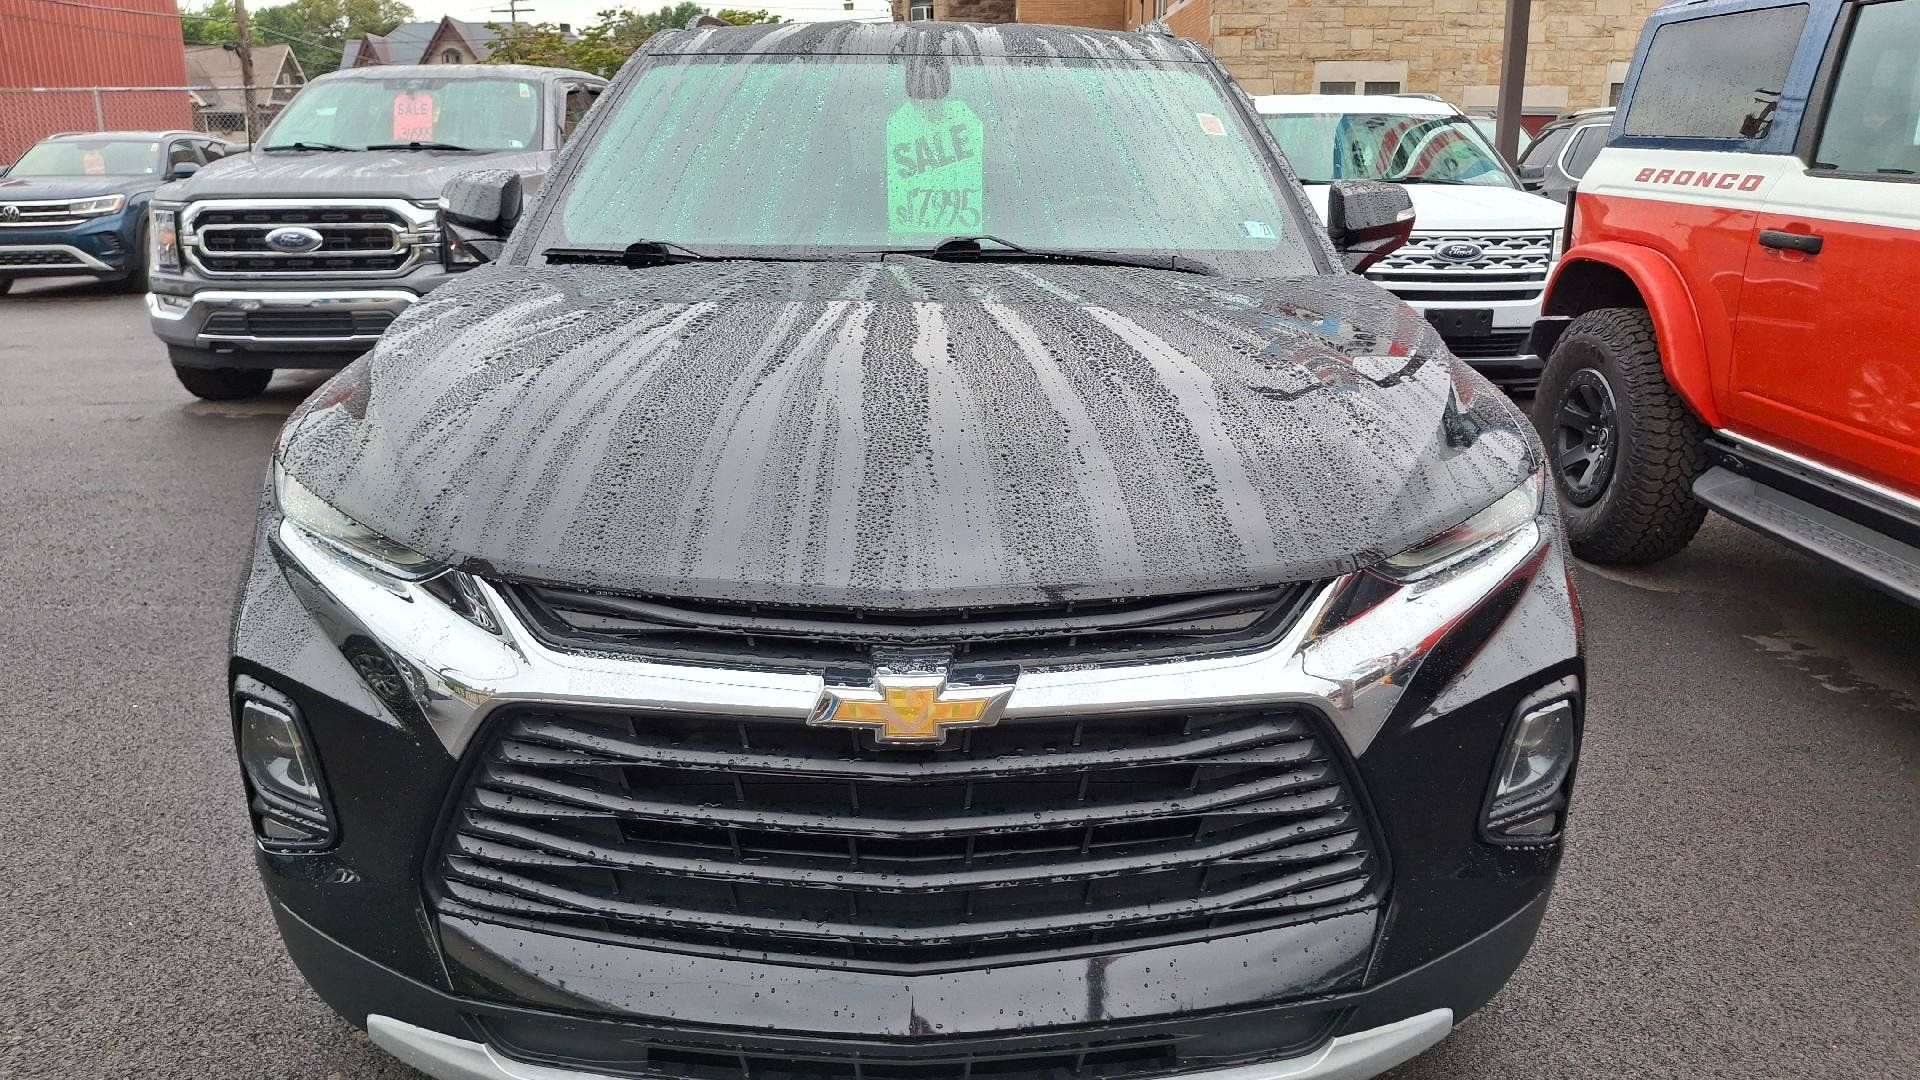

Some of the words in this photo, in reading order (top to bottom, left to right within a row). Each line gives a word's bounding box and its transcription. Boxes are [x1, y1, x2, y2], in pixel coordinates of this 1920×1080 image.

[398, 103, 429, 115] SALE
[893, 123, 976, 179] SALE
[1634, 167, 1766, 192] BRONCO
[1448, 245, 1474, 256] Ford
